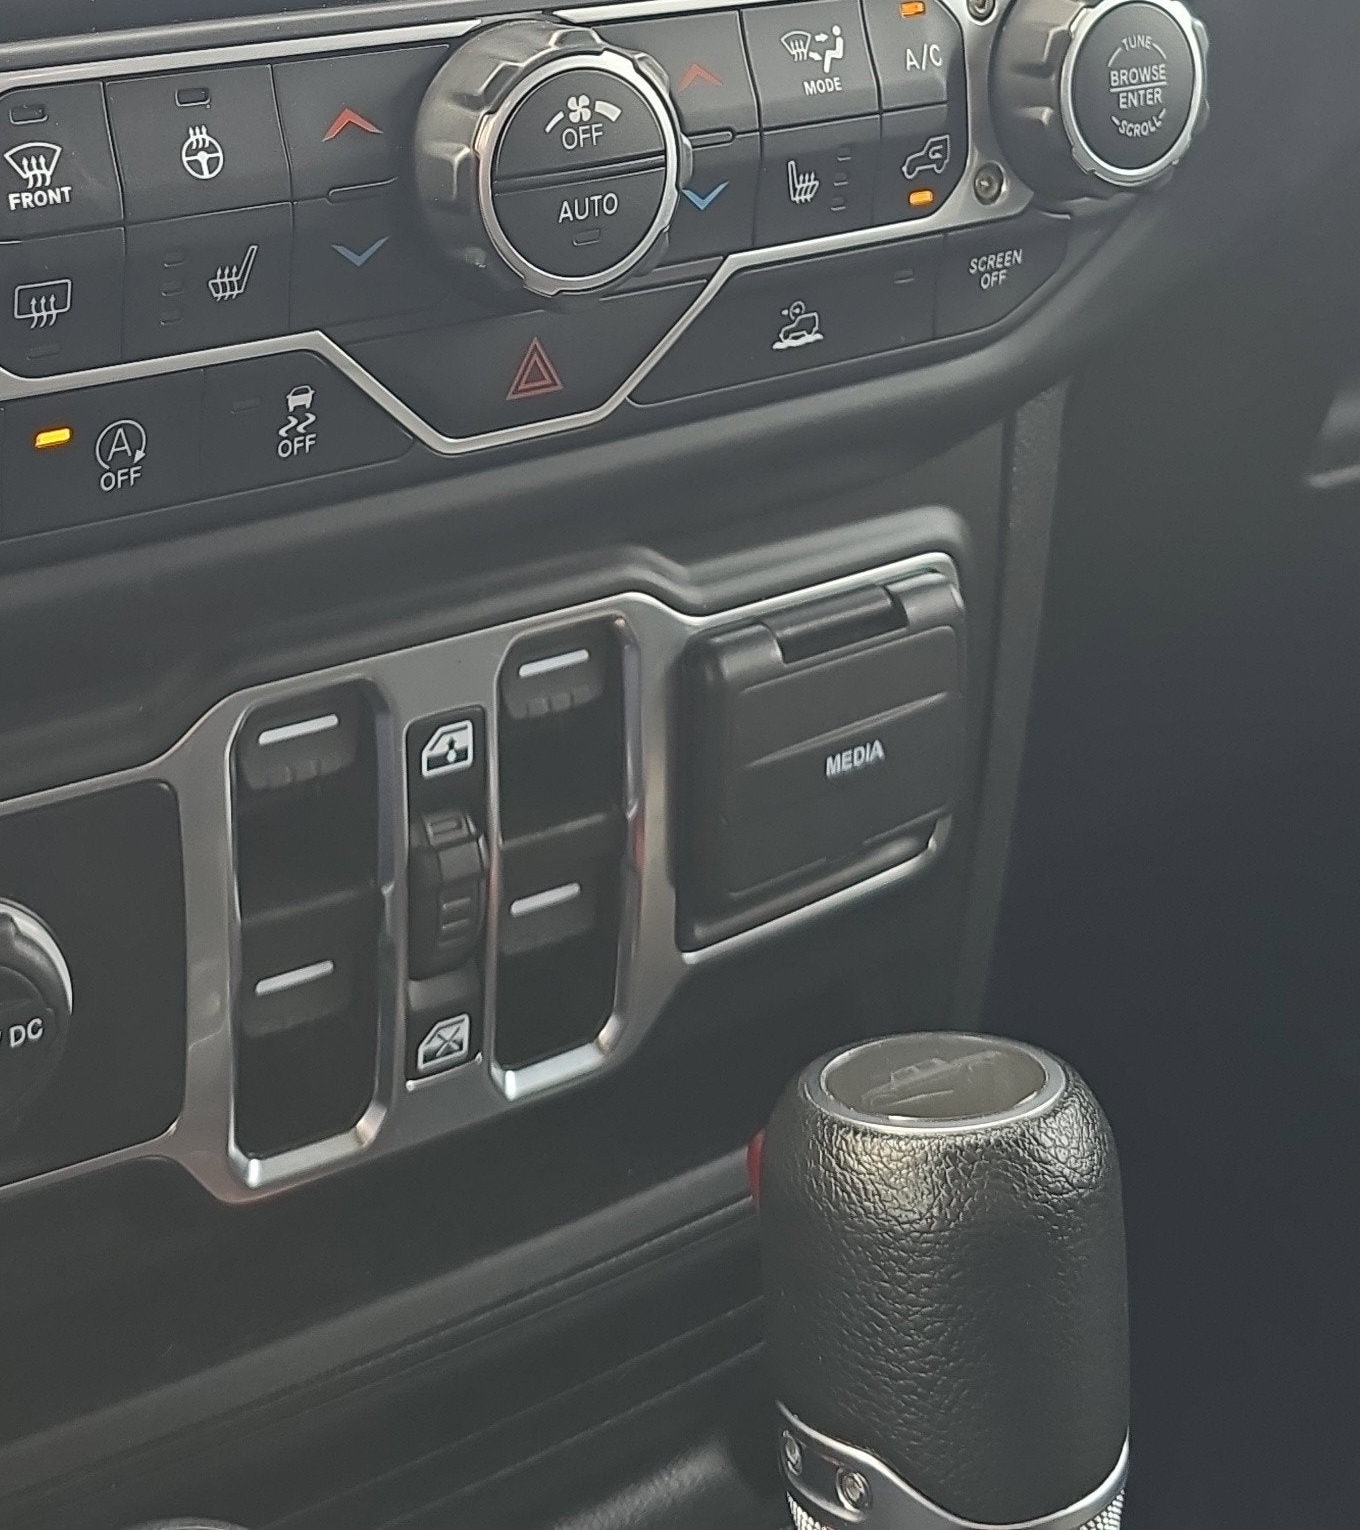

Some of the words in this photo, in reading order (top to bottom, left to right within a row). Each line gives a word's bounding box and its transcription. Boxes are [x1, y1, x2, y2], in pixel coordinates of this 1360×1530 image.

[1122, 34, 1154, 52] TUNE
[905, 43, 944, 73] A/C
[804, 76, 843, 96] MODE
[1110, 64, 1167, 86] BROWSE
[1118, 87, 1163, 110] ENTER
[562, 123, 604, 150] OFF
[1117, 114, 1161, 138] SCROLL
[8, 186, 73, 211] FRONT
[558, 192, 619, 223] AUTO
[969, 248, 1023, 274] SCREEN
[980, 270, 1008, 290] OFF
[277, 433, 317, 459] OFF
[100, 466, 142, 493] OFF
[826, 739, 886, 779] MEDIA
[9, 1017, 44, 1048] DC
